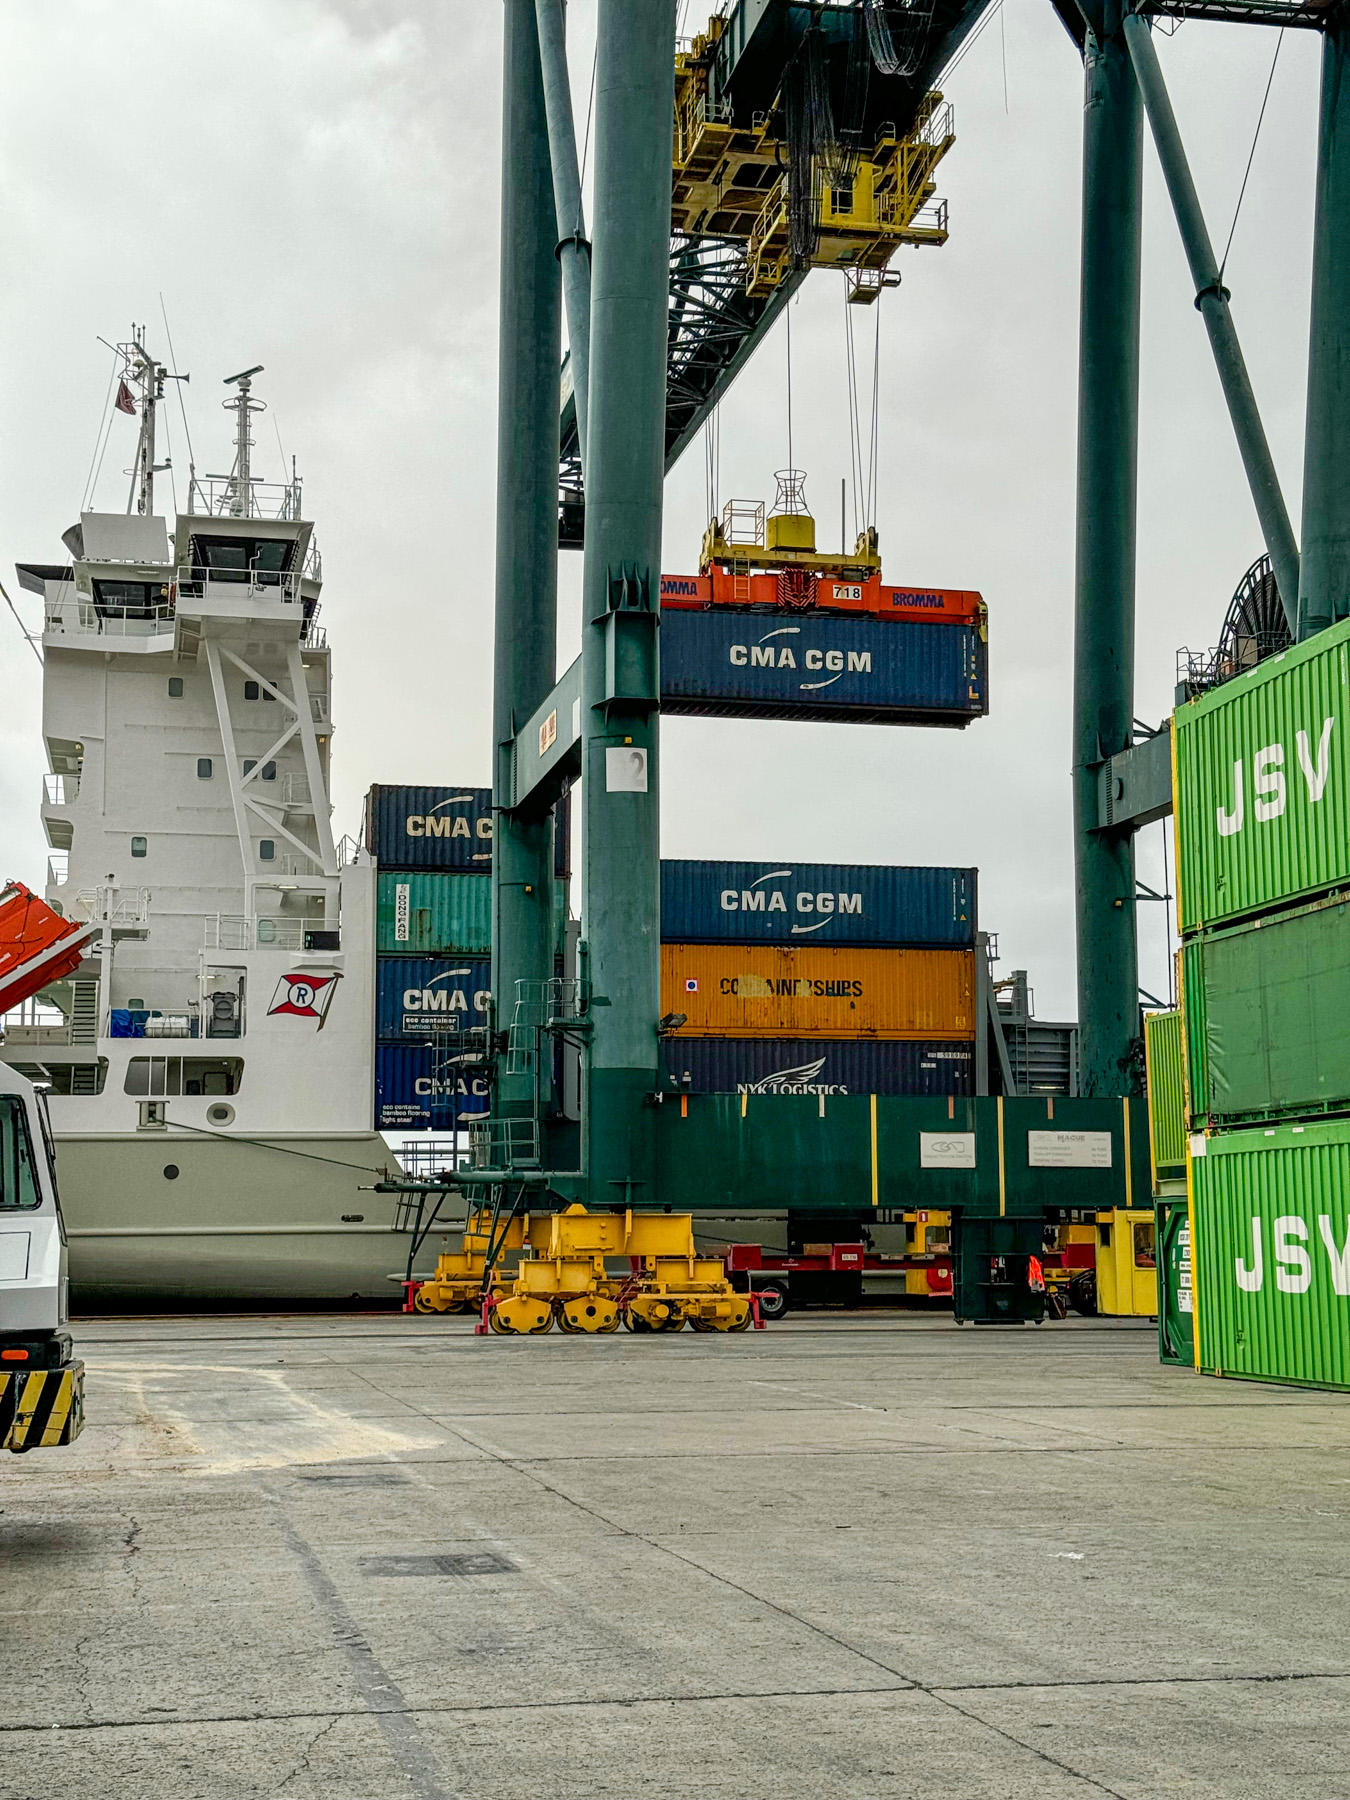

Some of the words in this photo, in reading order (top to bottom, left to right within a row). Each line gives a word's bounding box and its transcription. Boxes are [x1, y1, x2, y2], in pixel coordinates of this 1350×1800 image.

[660, 580, 698, 596] OMMA
[834, 586, 861, 599] 718
[892, 592, 945, 609] BROMMA
[729, 644, 797, 669] CMA
[805, 649, 872, 673] CGM
[1216, 716, 1335, 837] JSV
[406, 815, 472, 838] CMA
[720, 889, 788, 912] CMA
[796, 892, 863, 914] CGM
[296, 985, 306, 1005] R
[403, 988, 469, 1012] CMA
[414, 1077, 469, 1096] CMA
[1235, 1214, 1350, 1296] JSV
